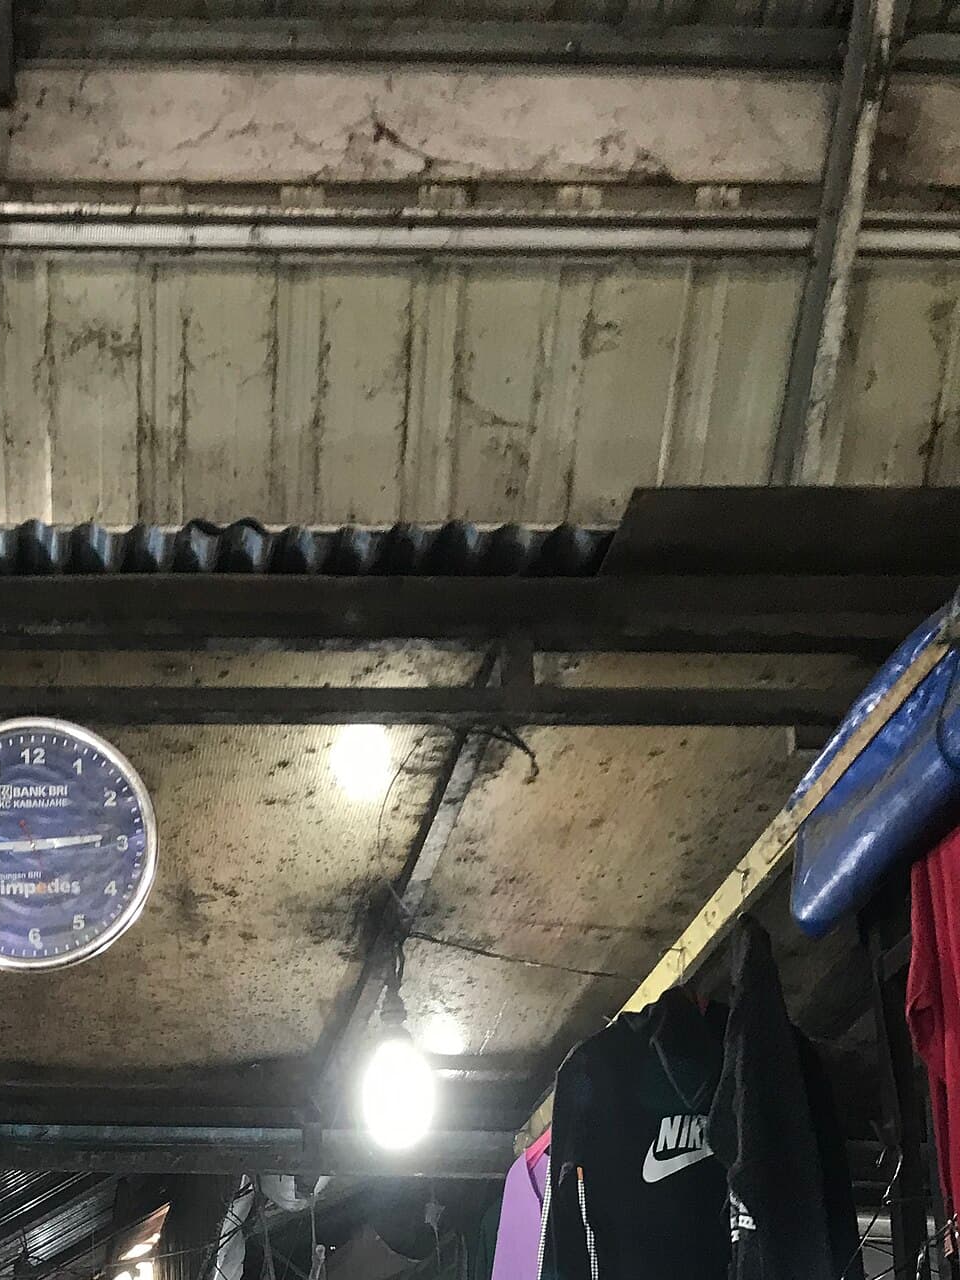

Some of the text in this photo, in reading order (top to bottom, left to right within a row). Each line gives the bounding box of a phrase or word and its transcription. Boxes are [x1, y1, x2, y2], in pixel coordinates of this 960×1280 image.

[20, 748, 46, 765] 12
[72, 758, 83, 776] 1
[13, 784, 68, 798] BANK BRI
[103, 789, 117, 807] 2
[116, 834, 129, 851] 3
[27, 871, 42, 879] BRI
[103, 880, 117, 897] 4
[72, 913, 86, 930] 5
[28, 928, 42, 946] 6
[655, 1114, 710, 1152] NIK
